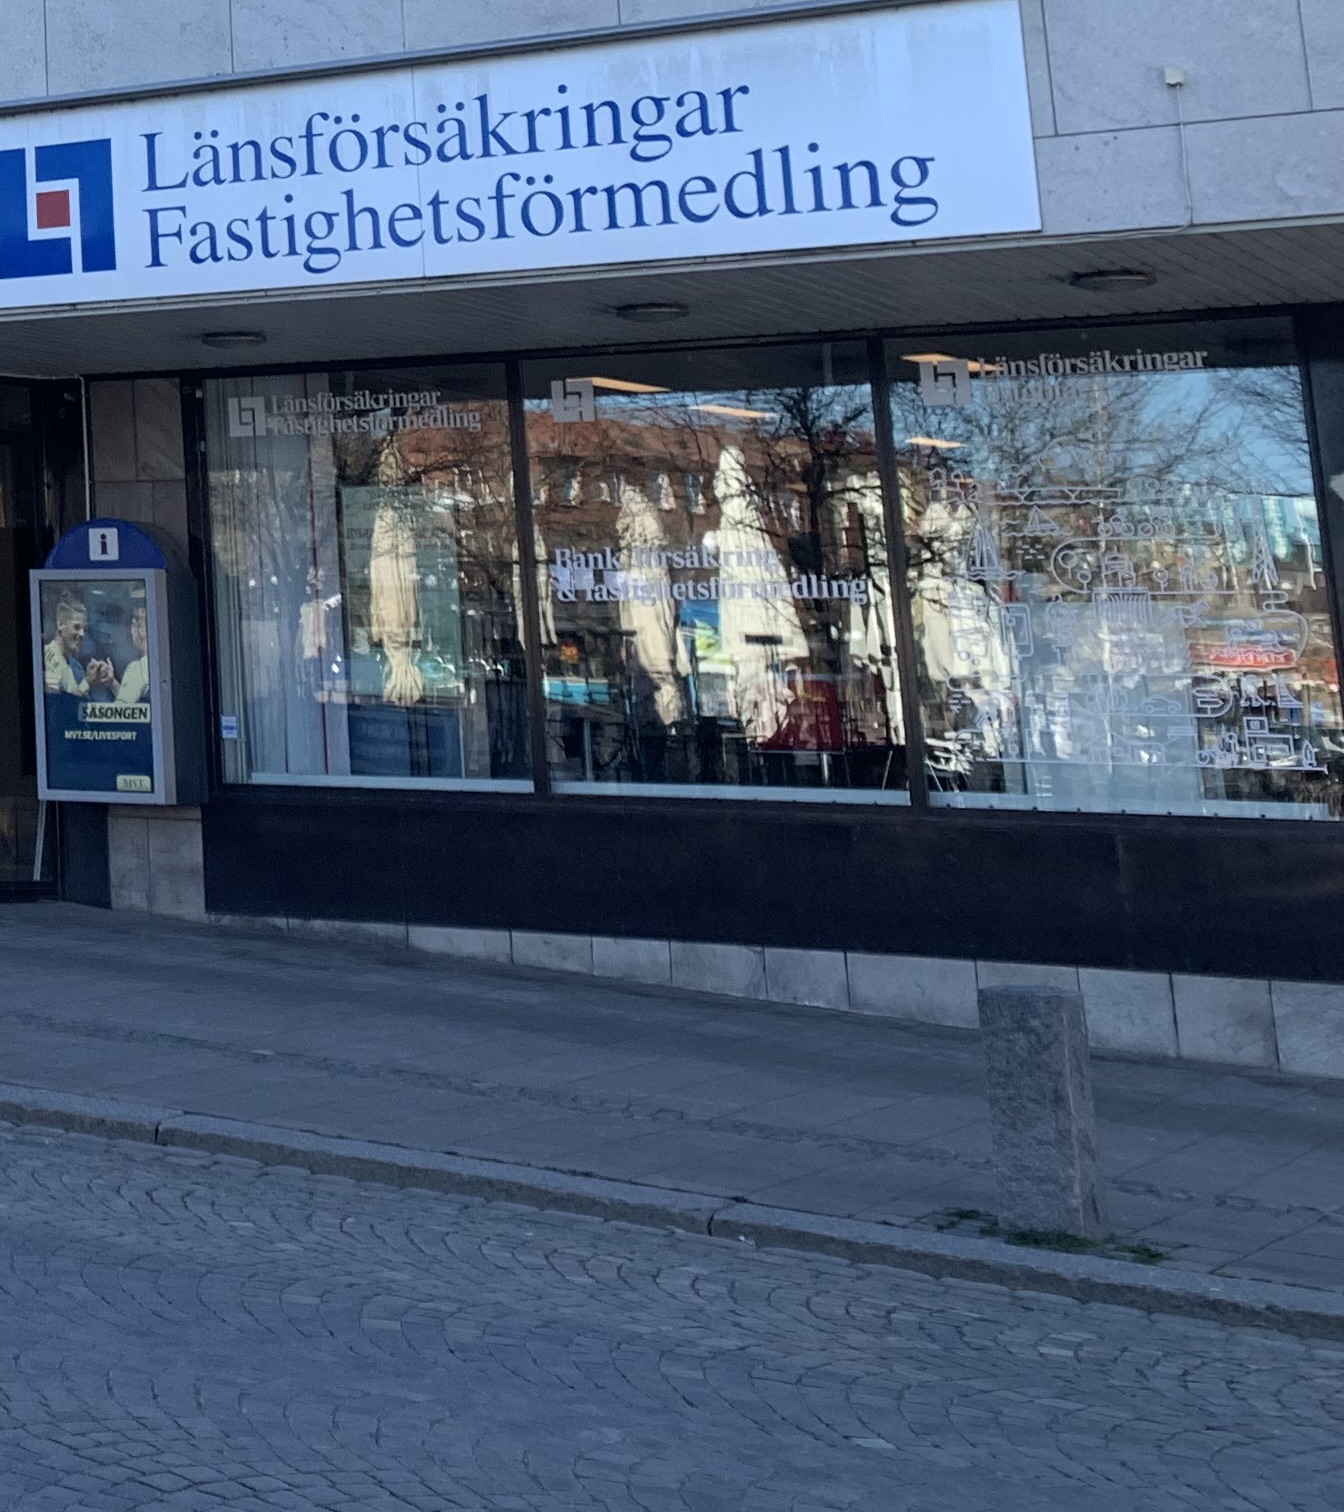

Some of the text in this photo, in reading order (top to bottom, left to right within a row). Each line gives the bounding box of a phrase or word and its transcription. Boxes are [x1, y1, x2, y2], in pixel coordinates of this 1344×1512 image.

[140, 83, 750, 192] Länsförsäkringar
[144, 144, 937, 275] Fastighetsförmedling
[978, 348, 1209, 379] Länsförsäkringar
[271, 389, 442, 414] Länsförsäkringar
[82, 704, 148, 720] SÄSONGEN
